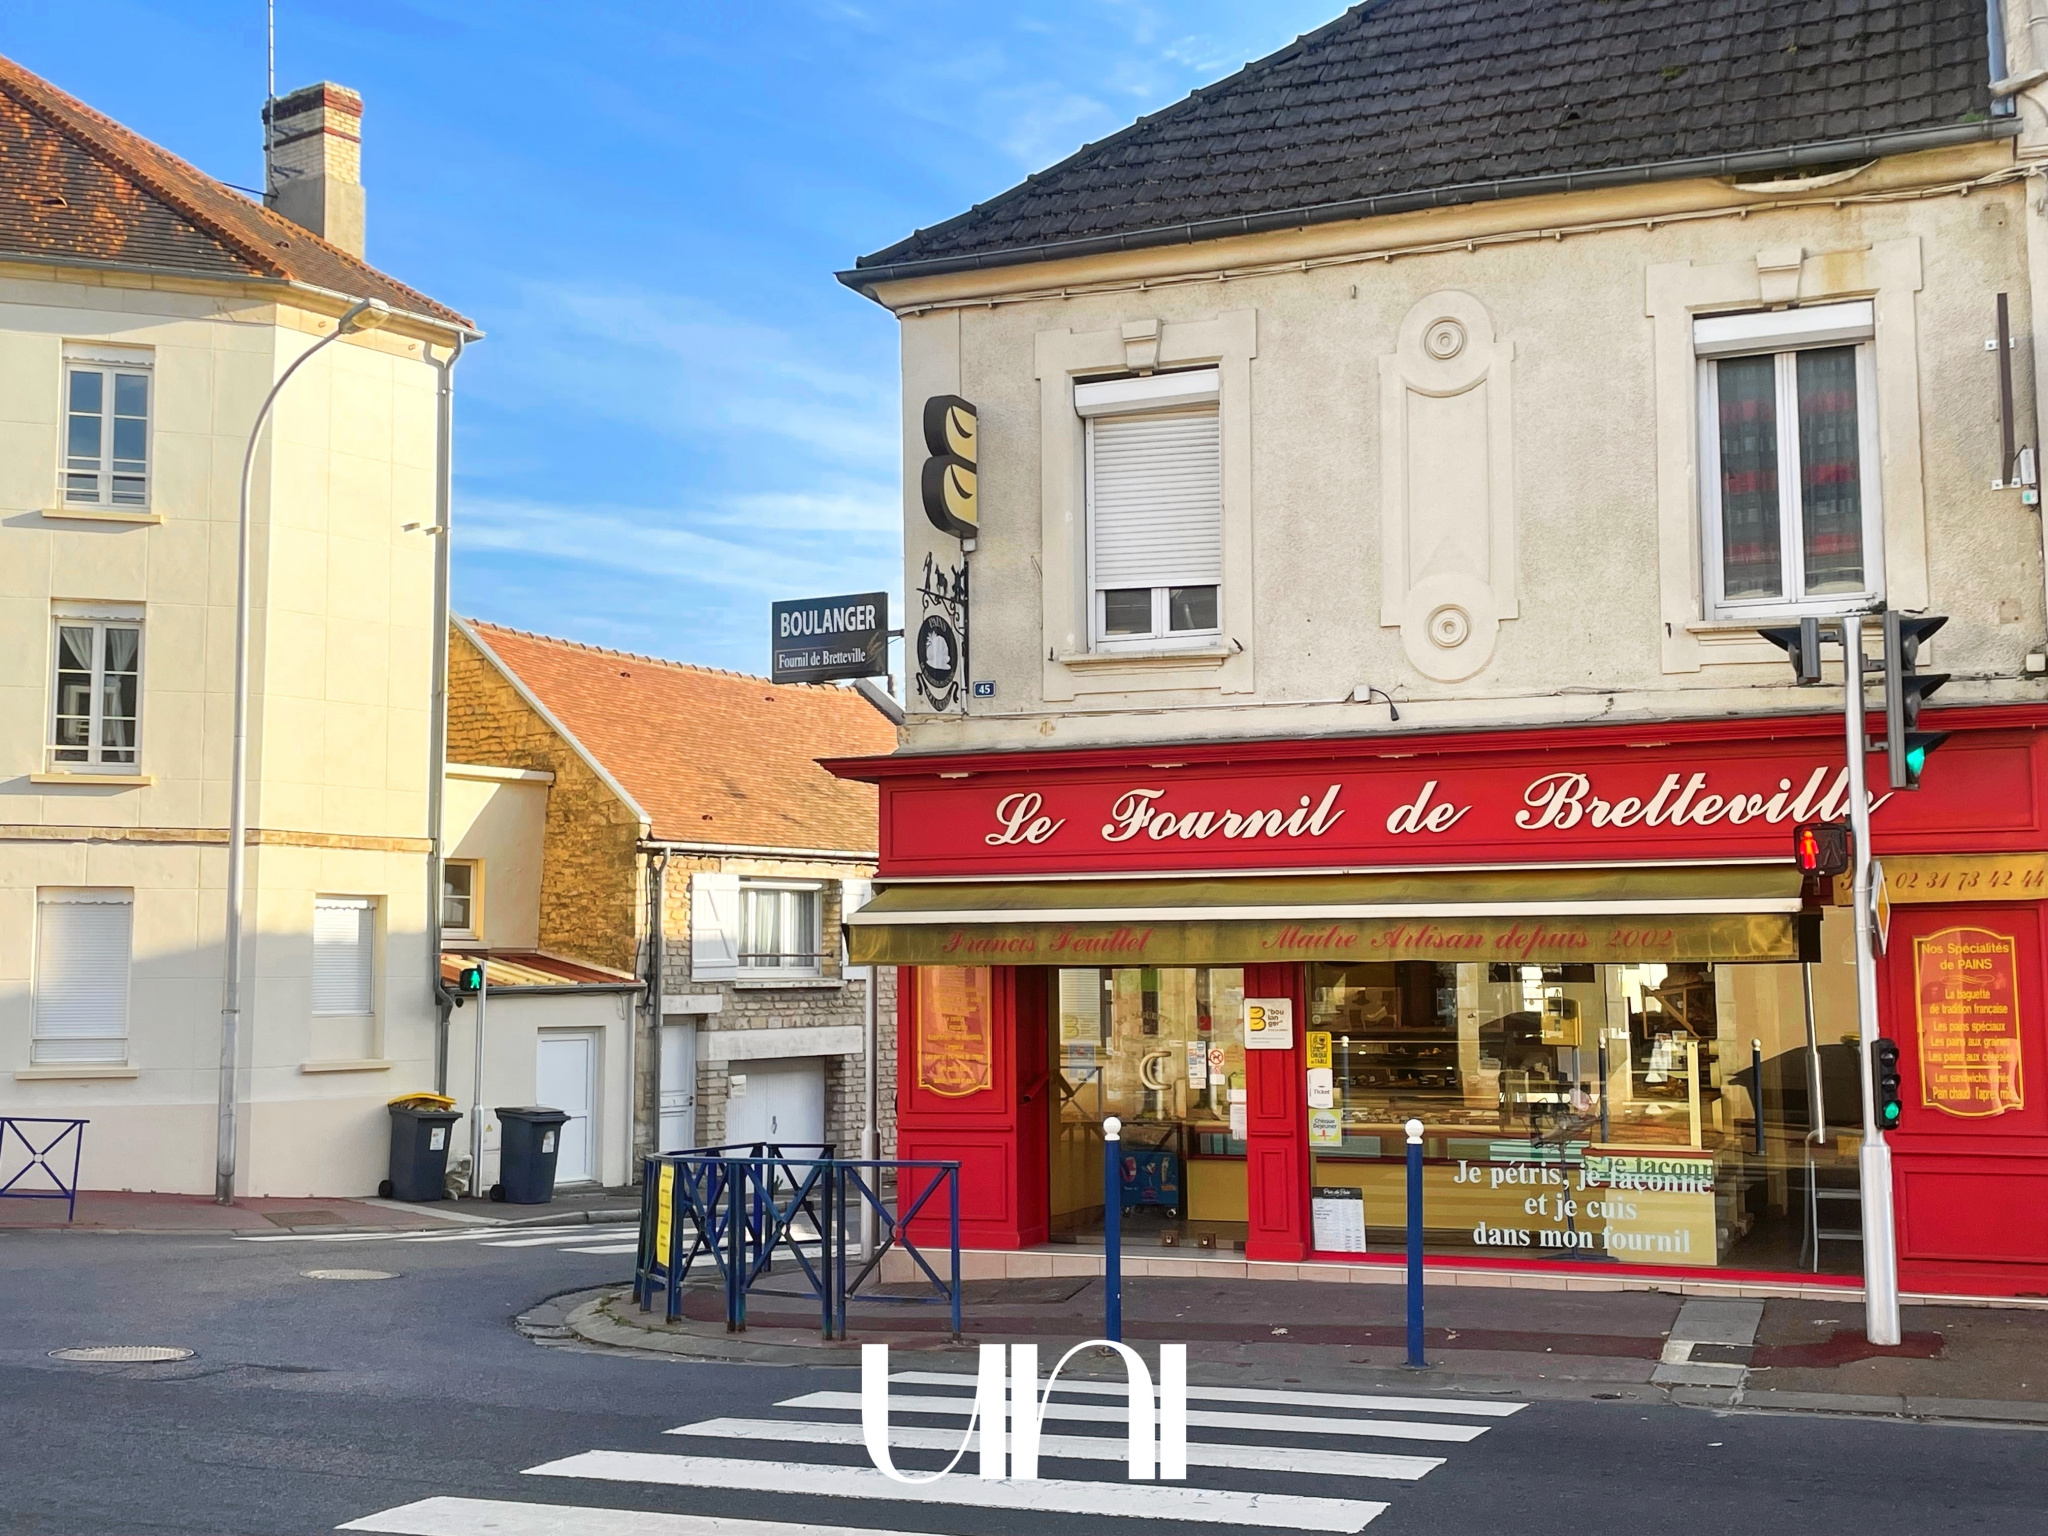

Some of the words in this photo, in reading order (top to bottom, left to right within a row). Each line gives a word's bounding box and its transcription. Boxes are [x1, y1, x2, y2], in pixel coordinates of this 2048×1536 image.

[780, 604, 876, 638] BOULANGER
[778, 651, 809, 669] Fournil
[810, 651, 821, 666] de
[822, 647, 866, 665] Bretteville
[979, 684, 991, 695] 45
[984, 792, 1066, 846] Le
[1101, 783, 1346, 842] Fournil
[1386, 780, 1473, 834] de
[1896, 872, 1919, 889] 02
[1926, 871, 1951, 888] 31
[1958, 871, 1981, 891] 73
[1988, 870, 2013, 888] 42
[2020, 869, 2045, 889] 44
[942, 926, 1036, 953] Francis
[1371, 922, 1485, 949] Artisan
[1494, 921, 1589, 959] depuis
[1607, 928, 1675, 949] 2002
[1922, 943, 1943, 954] Nos
[1947, 941, 2010, 956] Spécialités
[1940, 959, 1954, 970] de
[1957, 958, 1993, 970] PAINS
[1945, 988, 1955, 999] La
[1957, 988, 1990, 1002] baguette
[1930, 1003, 1939, 1014] de
[1941, 1003, 1972, 1014] tradition
[1974, 1002, 2008, 1016] française
[1933, 1020, 1947, 1031] Les
[1949, 1021, 1970, 1033] pains
[1971, 1020, 2006, 1033] spéciaux
[1930, 1036, 1944, 1046] Les
[1946, 1036, 1966, 1048] pains
[1968, 1037, 1981, 1046] aux
[1928, 1051, 1942, 1062] Les
[1944, 1051, 1965, 1063] pains
[1966, 1052, 1980, 1062] aux
[1935, 1072, 1948, 1083] Les
[1454, 1160, 1482, 1184] Je
[1490, 1159, 1569, 1190] pétris,
[1576, 1163, 1600, 1191] je
[1608, 1167, 1711, 1195] façonne
[1524, 1194, 1548, 1216] et
[1553, 1193, 1578, 1222] je
[1586, 1196, 1637, 1220] cuis
[1473, 1221, 1530, 1246] dans
[1538, 1229, 1594, 1249] mon
[1602, 1226, 1691, 1254] fournil
